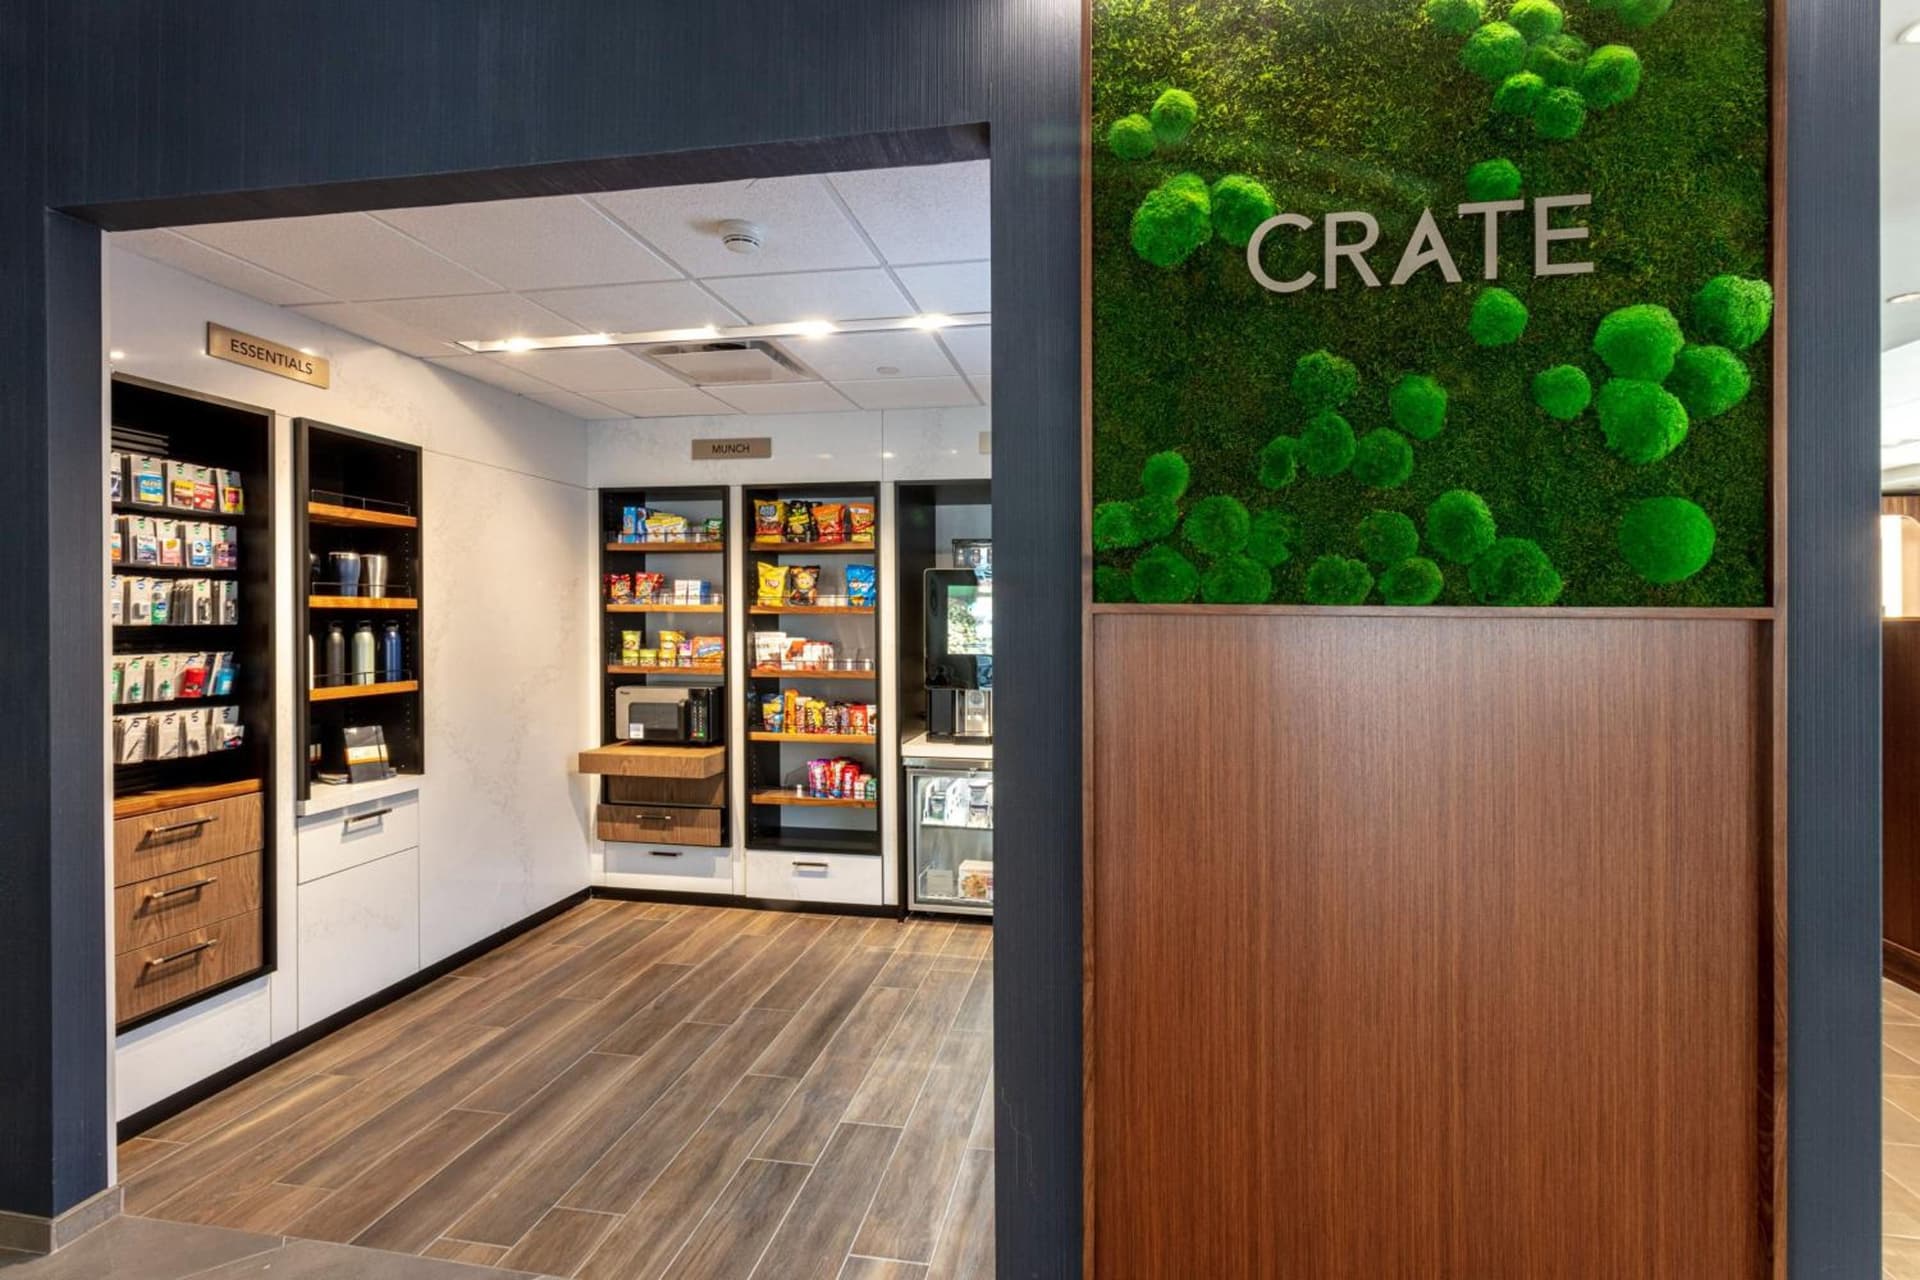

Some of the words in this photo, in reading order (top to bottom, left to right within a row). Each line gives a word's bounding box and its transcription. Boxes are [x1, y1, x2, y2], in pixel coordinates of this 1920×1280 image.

[1247, 193, 1595, 293] CRATE
[231, 339, 312, 375] ESSENTIALS
[712, 443, 750, 454] MUNCH
